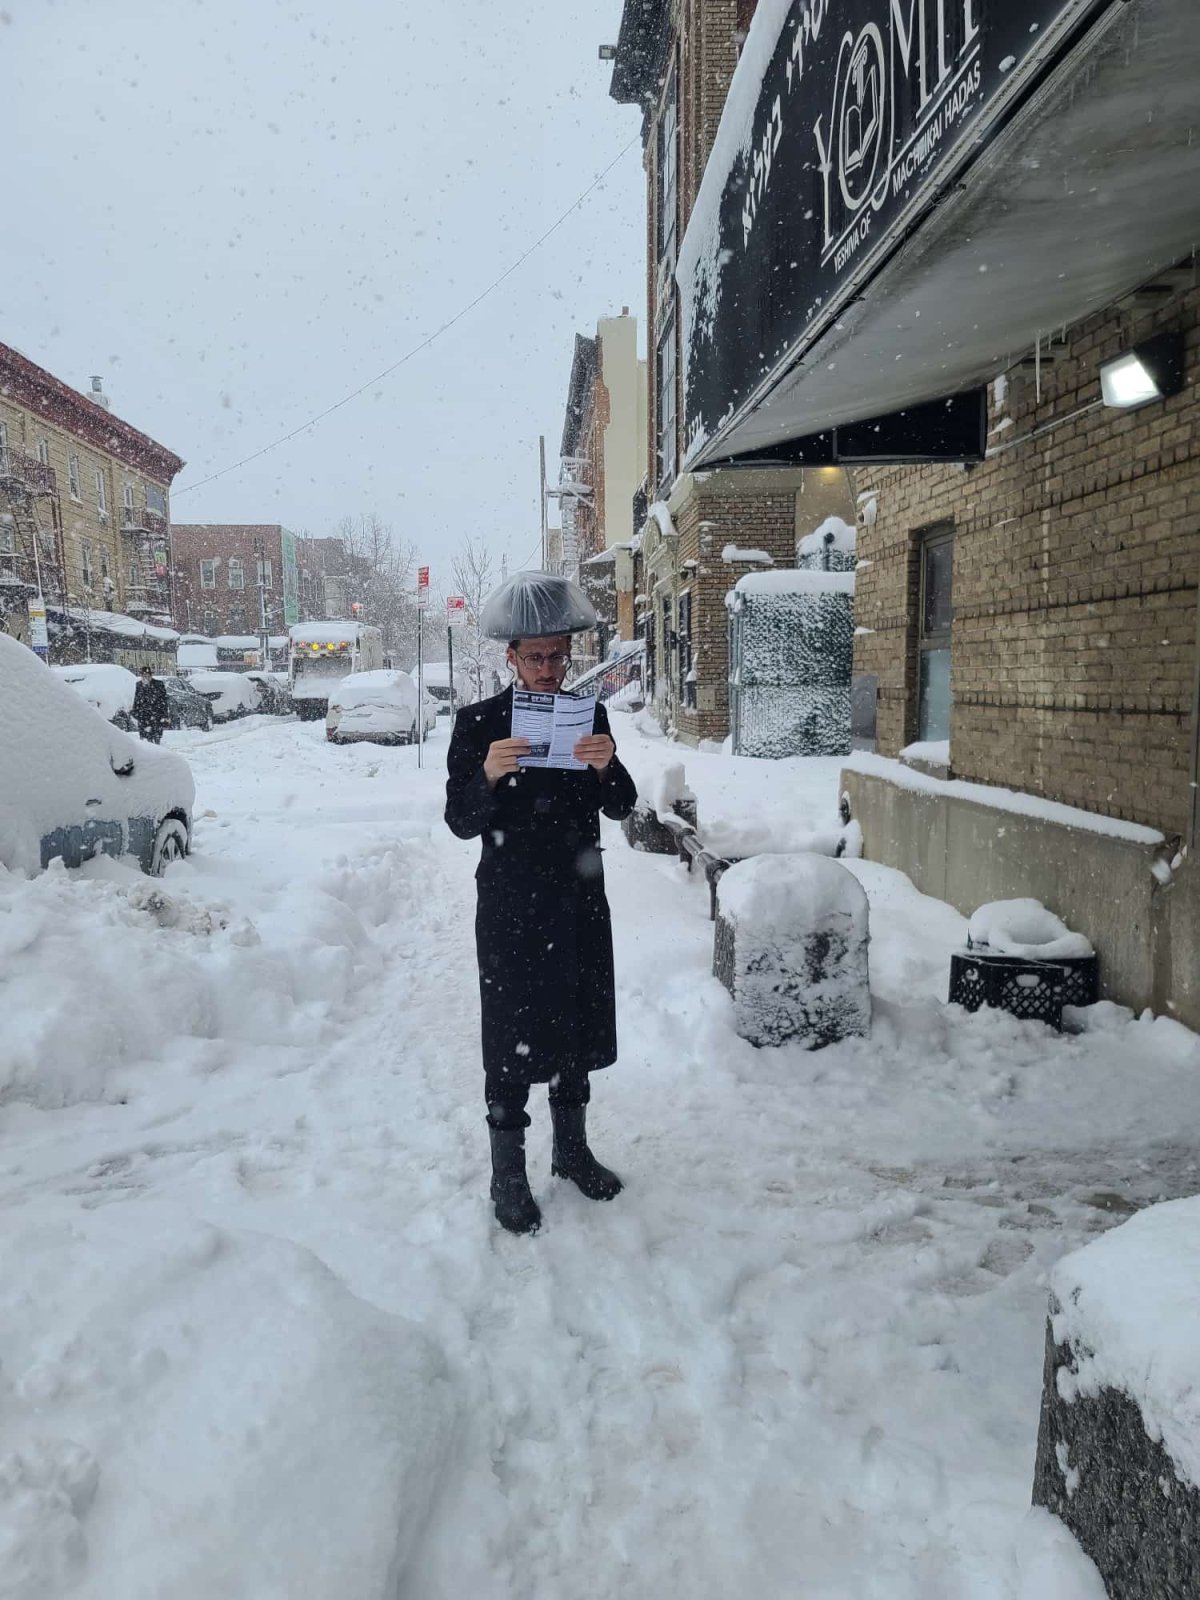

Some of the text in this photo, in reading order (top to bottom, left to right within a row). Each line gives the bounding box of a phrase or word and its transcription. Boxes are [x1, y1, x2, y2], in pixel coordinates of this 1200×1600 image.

[834, 231, 860, 274] YESHIVA
[860, 211, 872, 239] OF
[945, 60, 981, 129] HADAS
